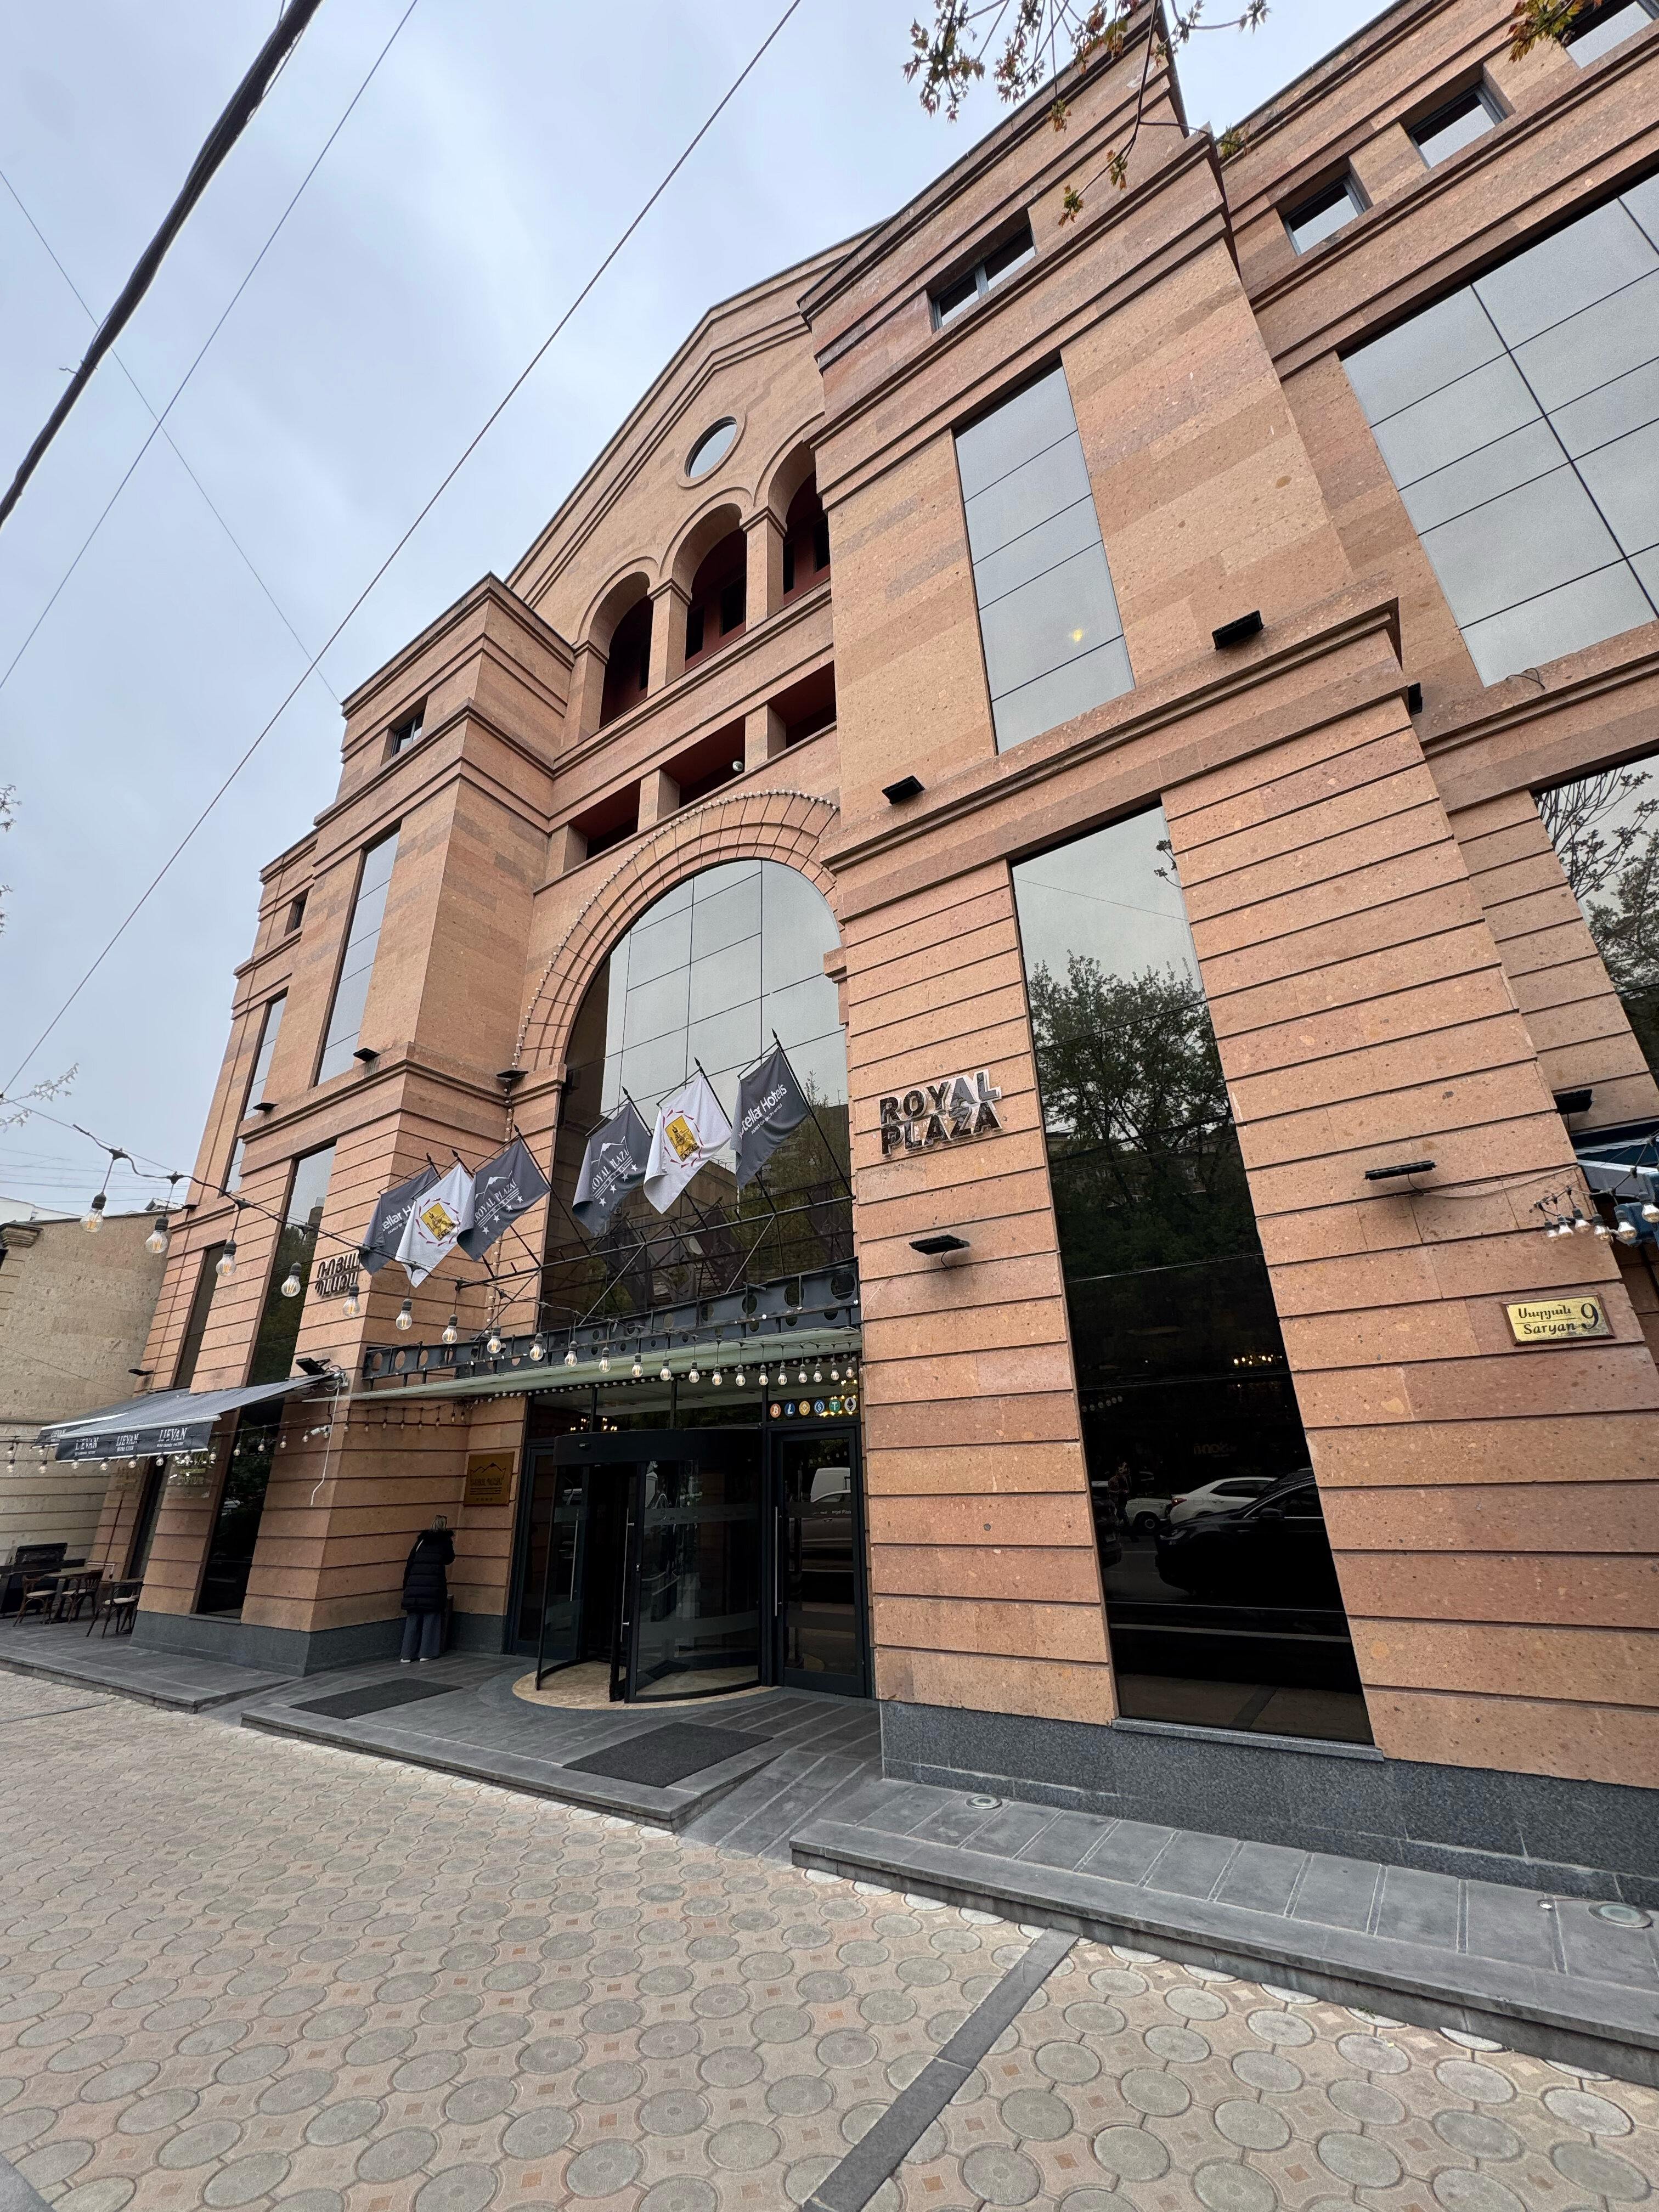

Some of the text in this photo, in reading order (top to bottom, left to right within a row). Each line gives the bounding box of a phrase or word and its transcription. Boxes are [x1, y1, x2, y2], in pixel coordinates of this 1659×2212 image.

[760, 1084, 787, 1113] Hotels
[879, 1070, 1001, 1126] ROYAL
[881, 1102, 1002, 1155] PLAZA
[610, 1149, 629, 1169] PLAZA
[494, 1182, 516, 1201] PLAZA
[1518, 1302, 1599, 1329] Սարյան 9
[1523, 1322, 1576, 1335] Saryan
